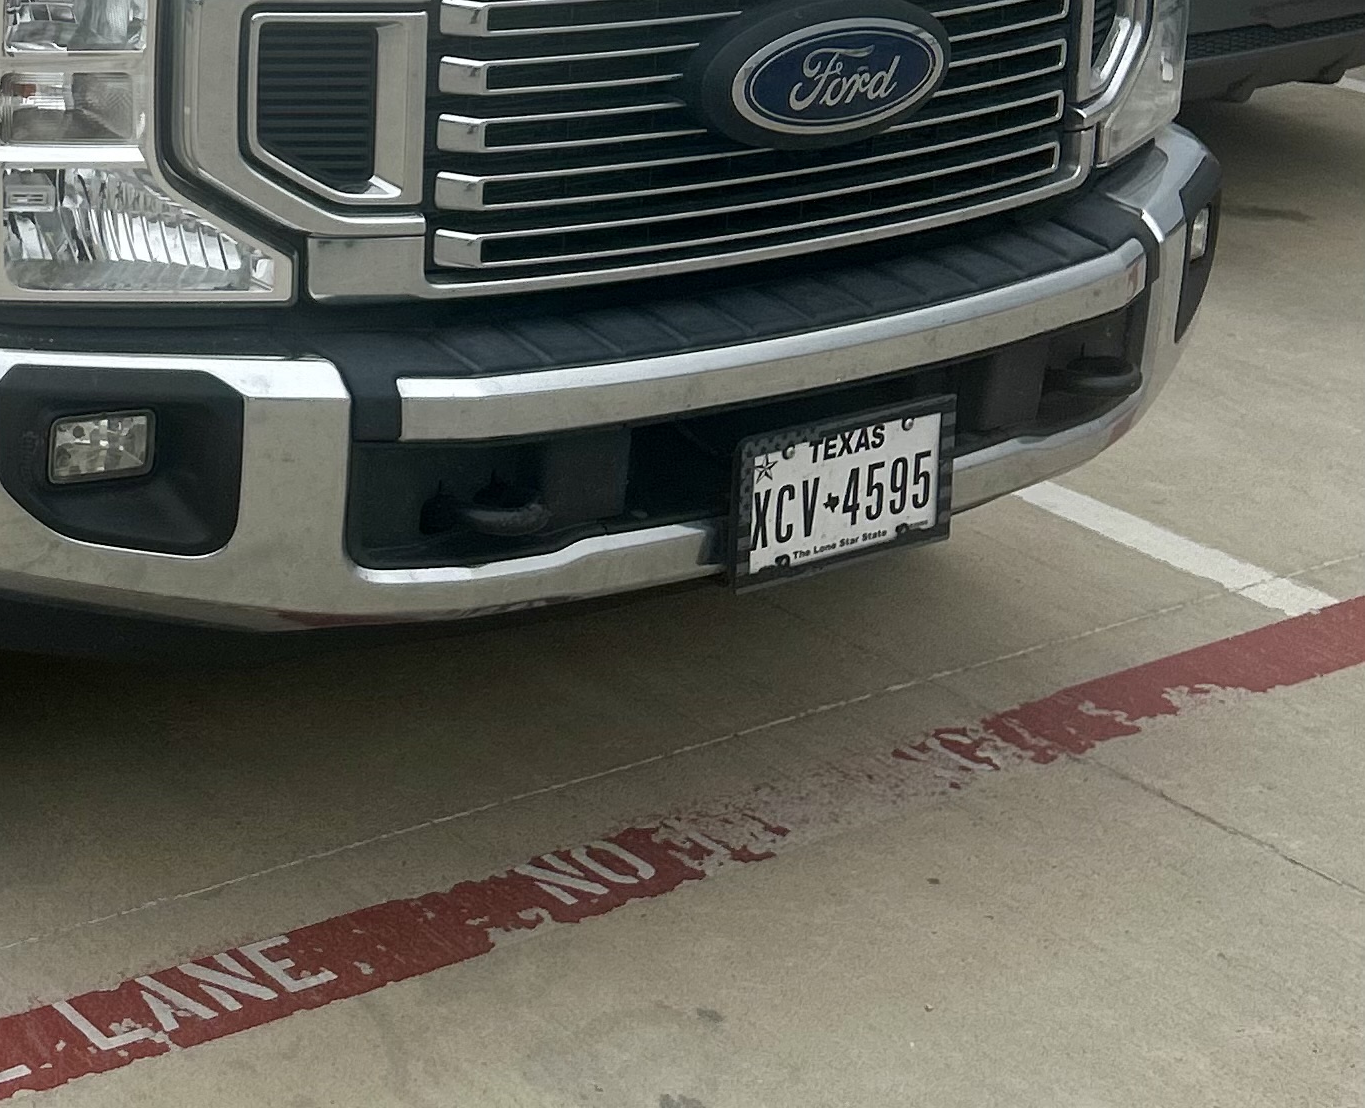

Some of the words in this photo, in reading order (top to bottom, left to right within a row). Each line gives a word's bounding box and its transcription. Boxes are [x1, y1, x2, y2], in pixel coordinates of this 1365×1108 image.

[789, 45, 901, 111] Ford
[809, 423, 885, 464] TEXAS
[751, 477, 820, 552] XCV
[842, 450, 932, 526] 4595
[793, 549, 811, 560] The
[814, 542, 837, 555] Lone
[840, 536, 860, 548] Star
[862, 529, 887, 542] State
[53, 934, 338, 1051] LANE
[514, 839, 657, 906] NO
